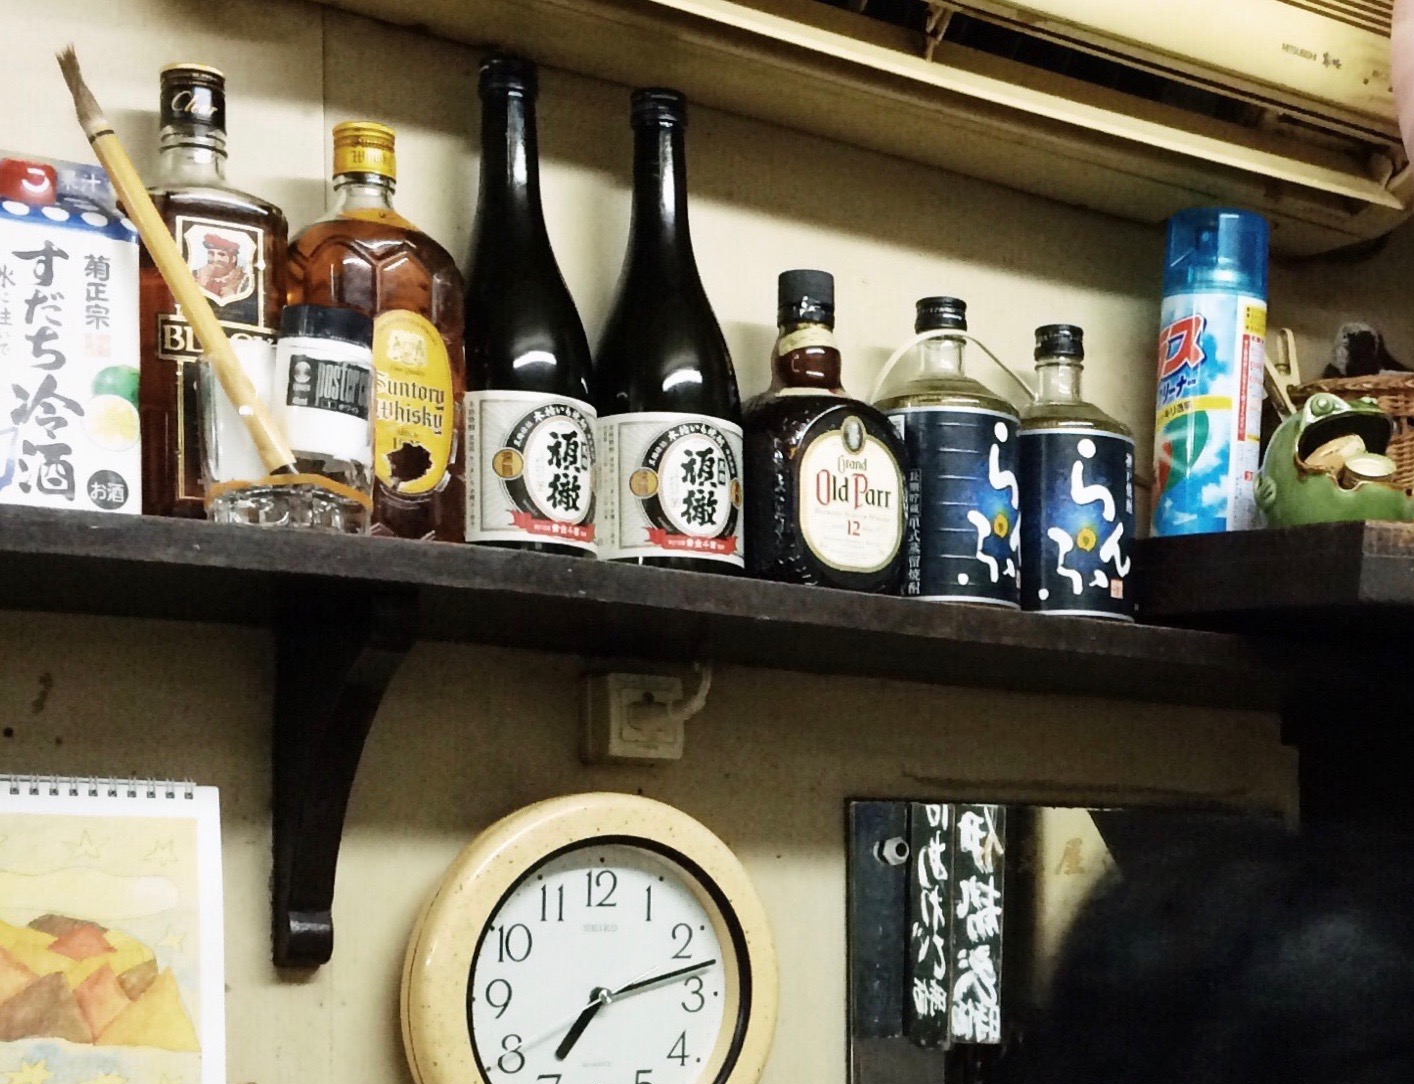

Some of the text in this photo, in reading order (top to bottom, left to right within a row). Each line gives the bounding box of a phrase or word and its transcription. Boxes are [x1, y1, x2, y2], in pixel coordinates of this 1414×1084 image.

[84, 254, 110, 330] 菊正宗
[10, 240, 84, 501] すだち冷酒
[838, 454, 868, 474] Grand
[90, 483, 125, 502] お酒
[816, 469, 891, 509] Old Parr
[847, 520, 861, 536] 12
[540, 884, 565, 921] 11
[585, 870, 618, 907] 12
[645, 886, 653, 921] 1
[498, 923, 533, 962] 10
[583, 924, 618, 932] SEIKO
[671, 923, 693, 959] 2
[485, 978, 513, 1019] 9
[681, 975, 705, 1012] 3
[498, 1034, 526, 1073] 8
[667, 1030, 689, 1066] 4
